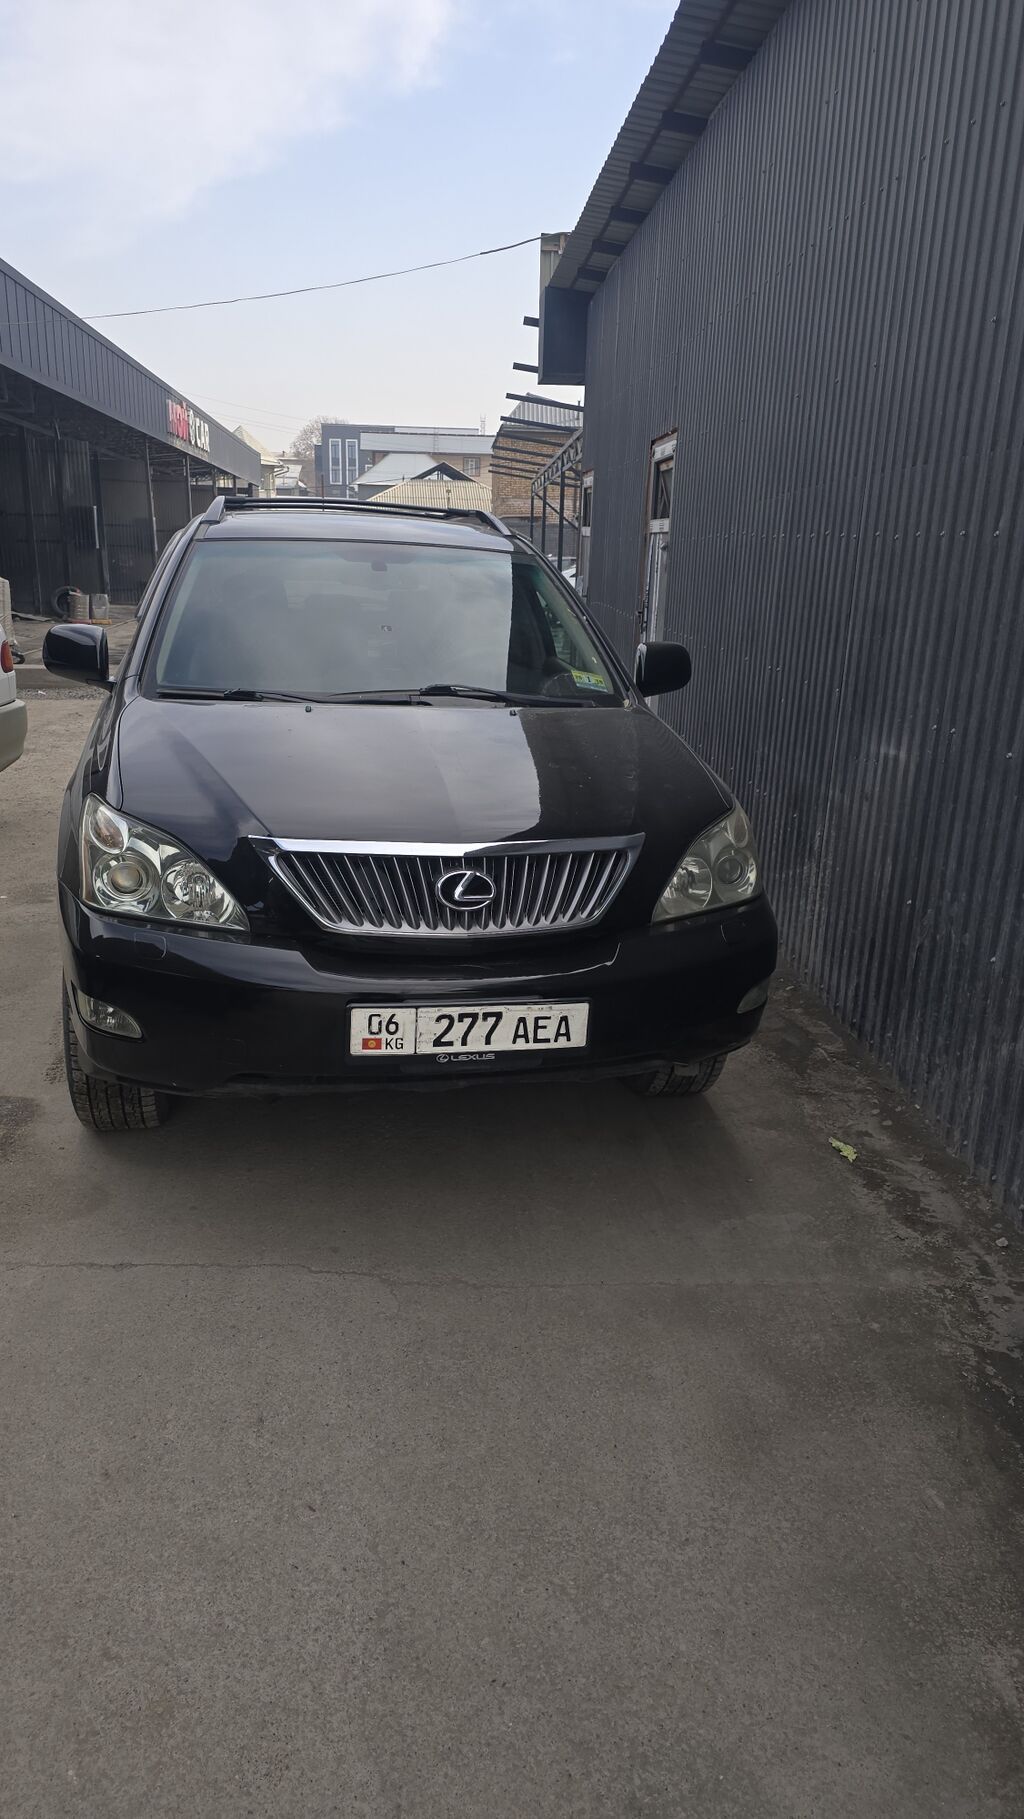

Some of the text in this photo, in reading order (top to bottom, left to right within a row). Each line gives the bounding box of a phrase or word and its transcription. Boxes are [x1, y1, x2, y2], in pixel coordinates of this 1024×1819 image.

[368, 1013, 399, 1036] 06
[432, 1011, 571, 1047] 277 AEA
[385, 1037, 404, 1050] KG
[450, 1053, 496, 1061] LEXUS
